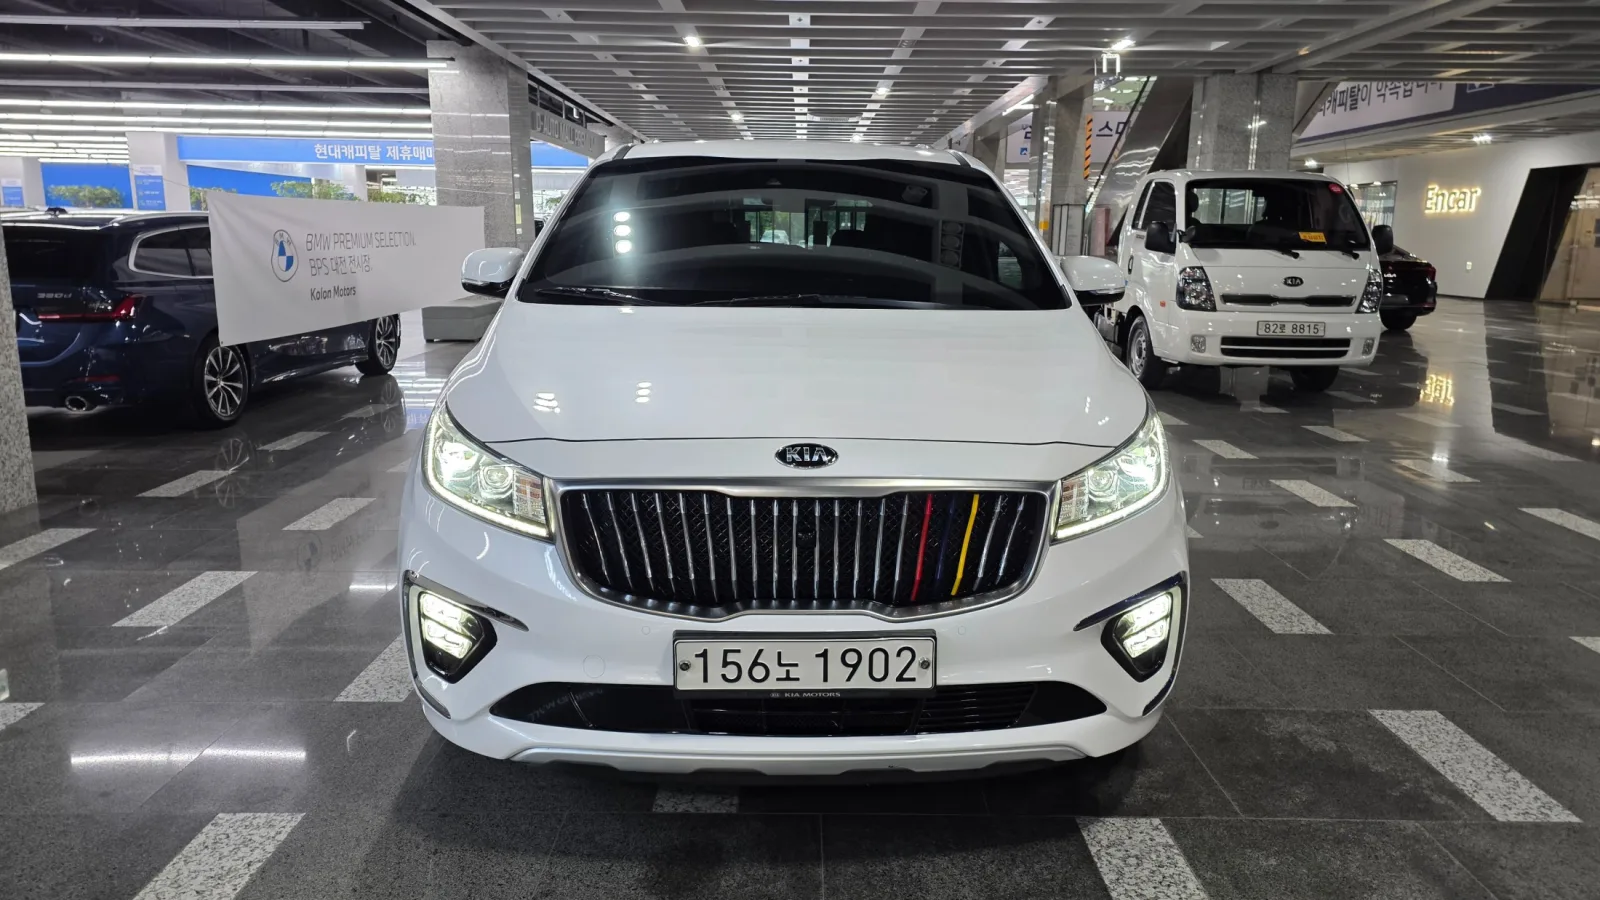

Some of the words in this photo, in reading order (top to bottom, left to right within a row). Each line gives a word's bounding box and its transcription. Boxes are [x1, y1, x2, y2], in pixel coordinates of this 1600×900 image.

[314, 143, 381, 160] 현대캐피탈
[1424, 184, 1481, 213] Encar
[306, 233, 330, 251] BMW
[333, 232, 374, 249] PREMIUM
[309, 257, 329, 276] BPS
[330, 256, 347, 275] 대전
[333, 284, 357, 298] Motors
[1264, 323, 1287, 334] 82로
[1291, 323, 1320, 335] 8815
[786, 446, 829, 463] KIA
[694, 647, 801, 684] 156노
[814, 645, 917, 683] 1902
